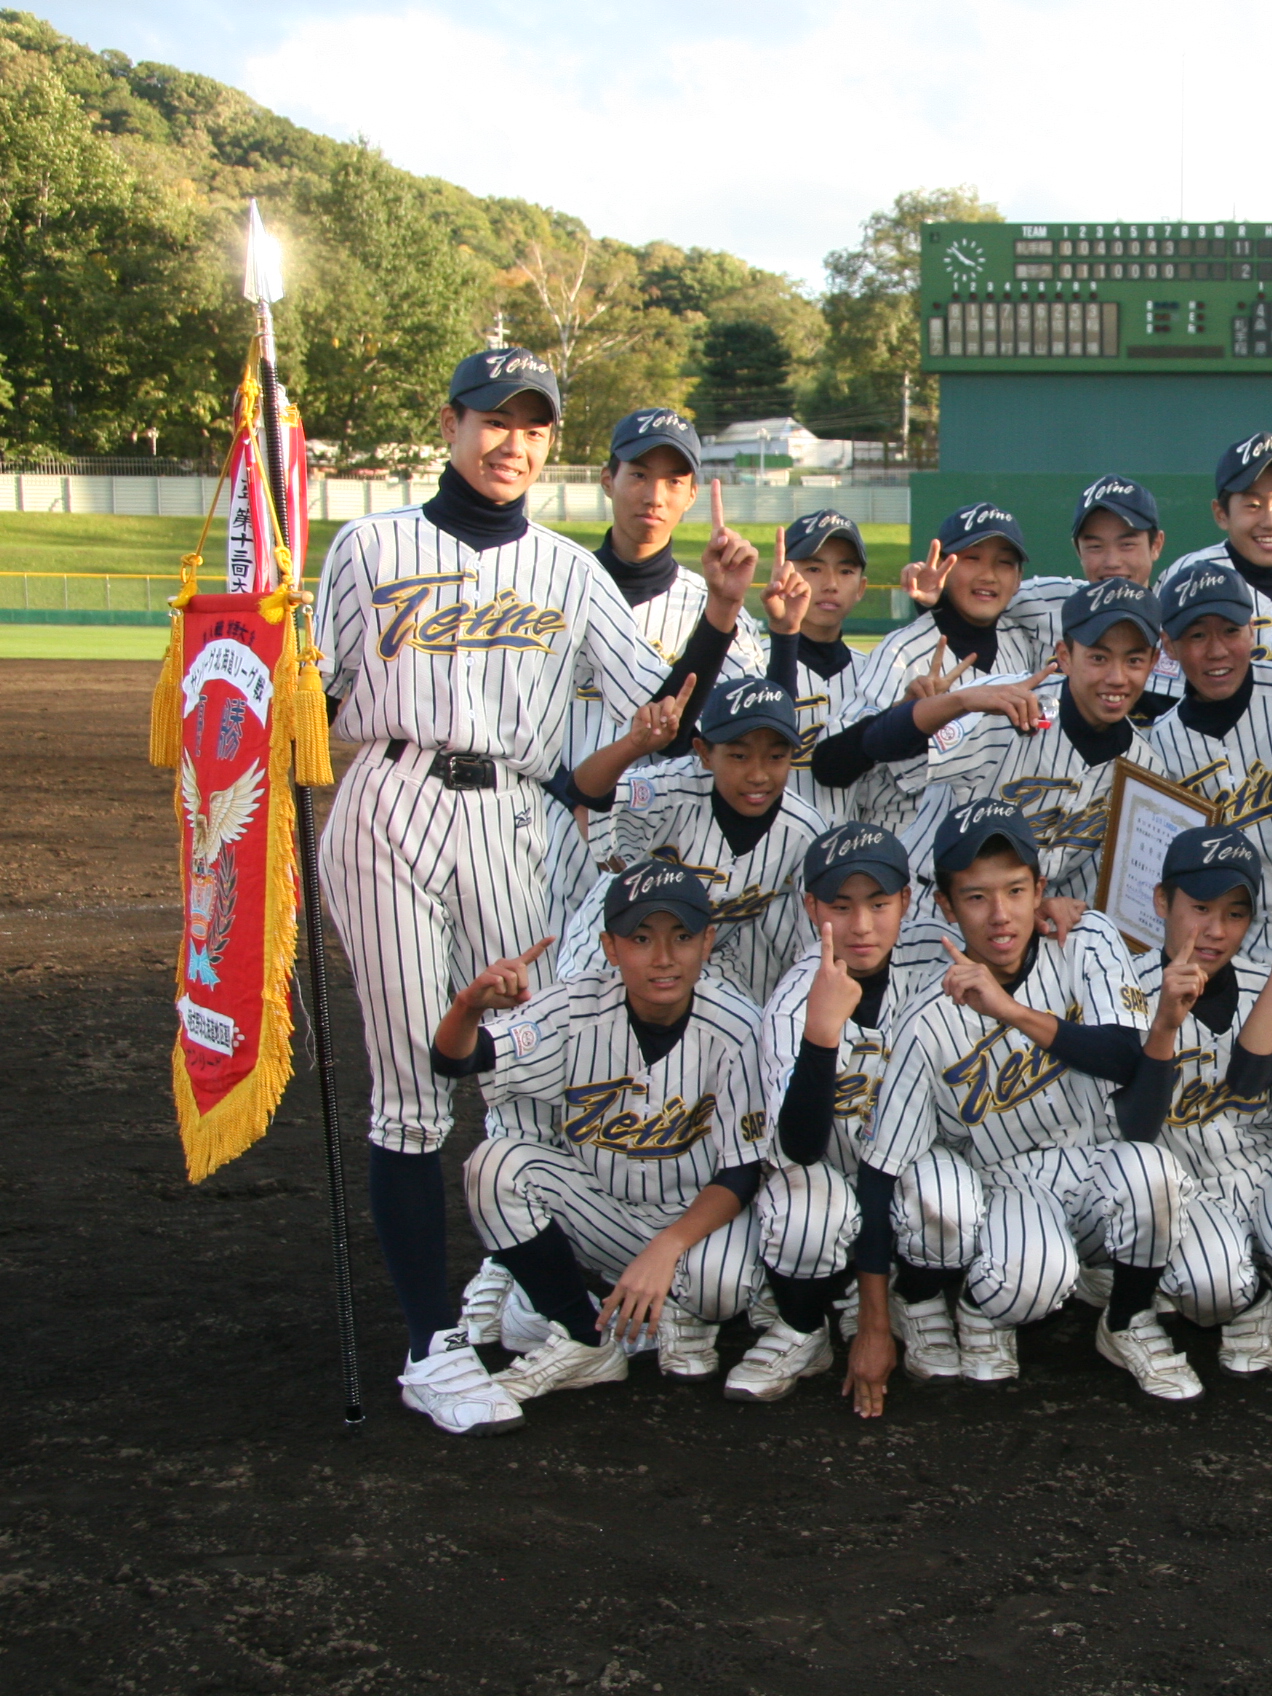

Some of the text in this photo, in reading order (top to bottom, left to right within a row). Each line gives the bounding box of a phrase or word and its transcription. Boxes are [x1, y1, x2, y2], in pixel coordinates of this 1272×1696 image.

[1022, 226, 1047, 237] TEAM
[1063, 226, 1068, 237] 1
[1080, 226, 1086, 237] 2
[1096, 226, 1103, 237] 3
[1113, 226, 1120, 237] 4
[1131, 226, 1137, 237] 5
[1147, 226, 1154, 237] 6
[1165, 226, 1171, 237] 7
[1182, 226, 1188, 237] 8
[1199, 226, 1205, 237] 9
[1215, 226, 1224, 237] 10
[1238, 226, 1246, 237] R
[1265, 226, 1272, 237] H
[1242, 264, 1249, 278] 2
[486, 347, 549, 379] Teine
[637, 408, 690, 435] Teine
[1083, 475, 1135, 508] Teine
[960, 503, 1013, 531] Teine
[1087, 577, 1145, 612] Teine
[371, 569, 567, 662] Teine
[726, 681, 783, 715] Teine
[954, 799, 1016, 834] Teine
[821, 825, 886, 865] Teine
[625, 864, 686, 901] Teine
